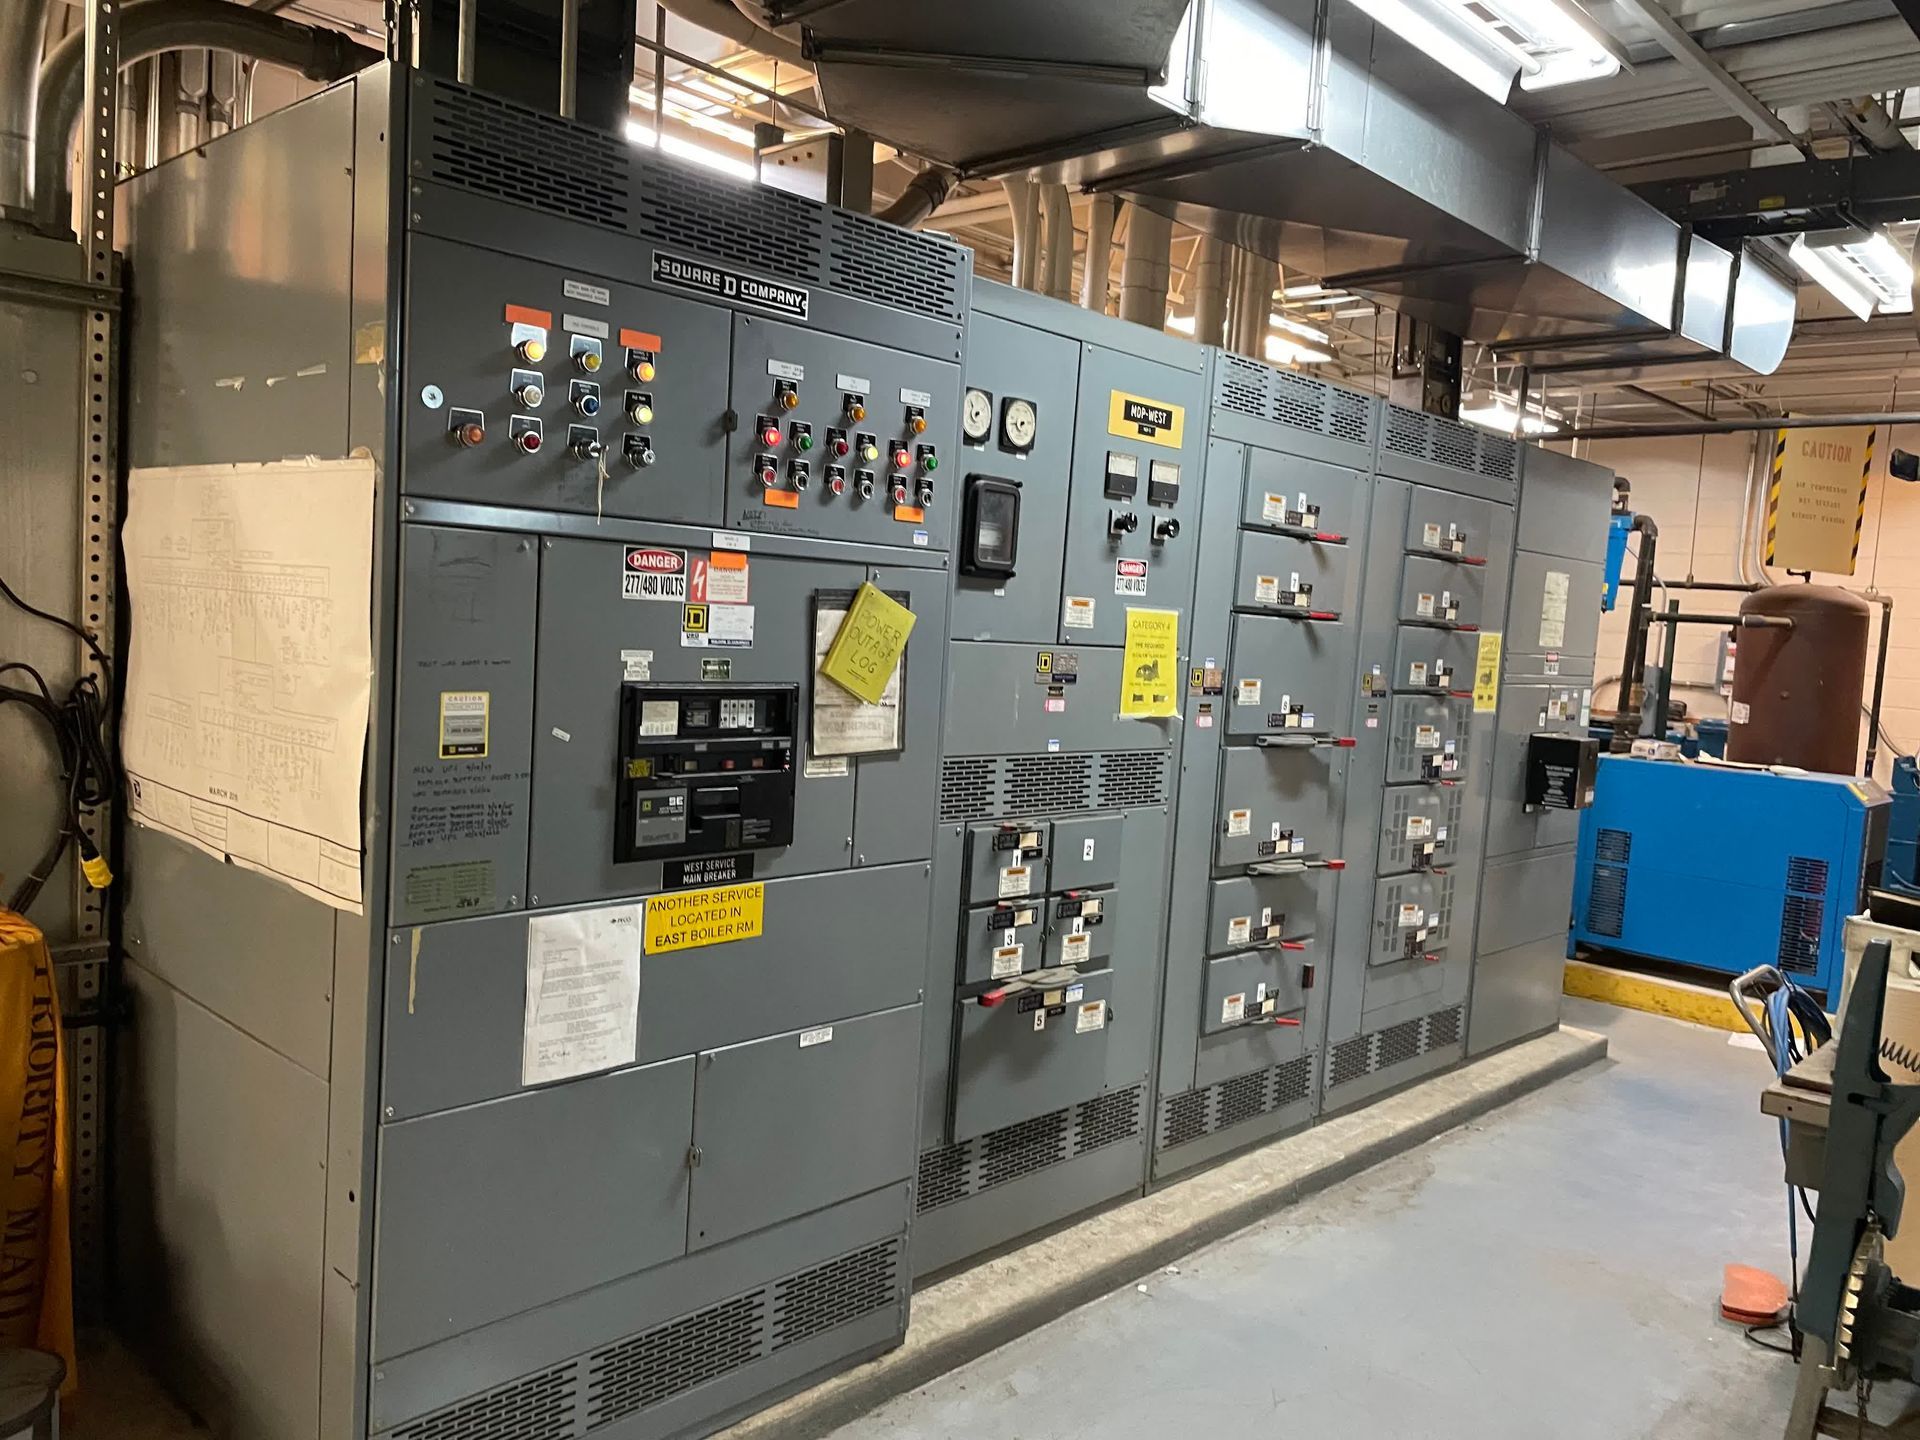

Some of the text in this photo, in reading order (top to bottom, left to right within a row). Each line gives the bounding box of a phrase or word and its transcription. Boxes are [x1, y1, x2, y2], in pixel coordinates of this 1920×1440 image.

[660, 259, 802, 307] SQUARE D COMPANY
[1130, 404, 1167, 425] MDP-WEST
[1801, 440, 1852, 463] CAUTION
[633, 554, 678, 569] DANGER
[1121, 562, 1144, 575] DANGER
[625, 574, 684, 597] 277/480 VOLTS
[861, 610, 902, 647] POWER
[1132, 619, 1166, 630] CATEGORY
[849, 626, 895, 663] OUTAGE
[850, 650, 878, 674] LOG
[1086, 845, 1092, 856] 2
[684, 858, 736, 873] WEST SERVICE
[683, 869, 737, 885] MAIN BREAKER
[649, 886, 762, 912] ANOTHER SERVICE
[670, 906, 742, 928] LOCATED IN
[655, 920, 754, 947] EAST BOILER RM
[1007, 934, 1012, 945] 3
[1036, 1015, 1043, 1026] 5
